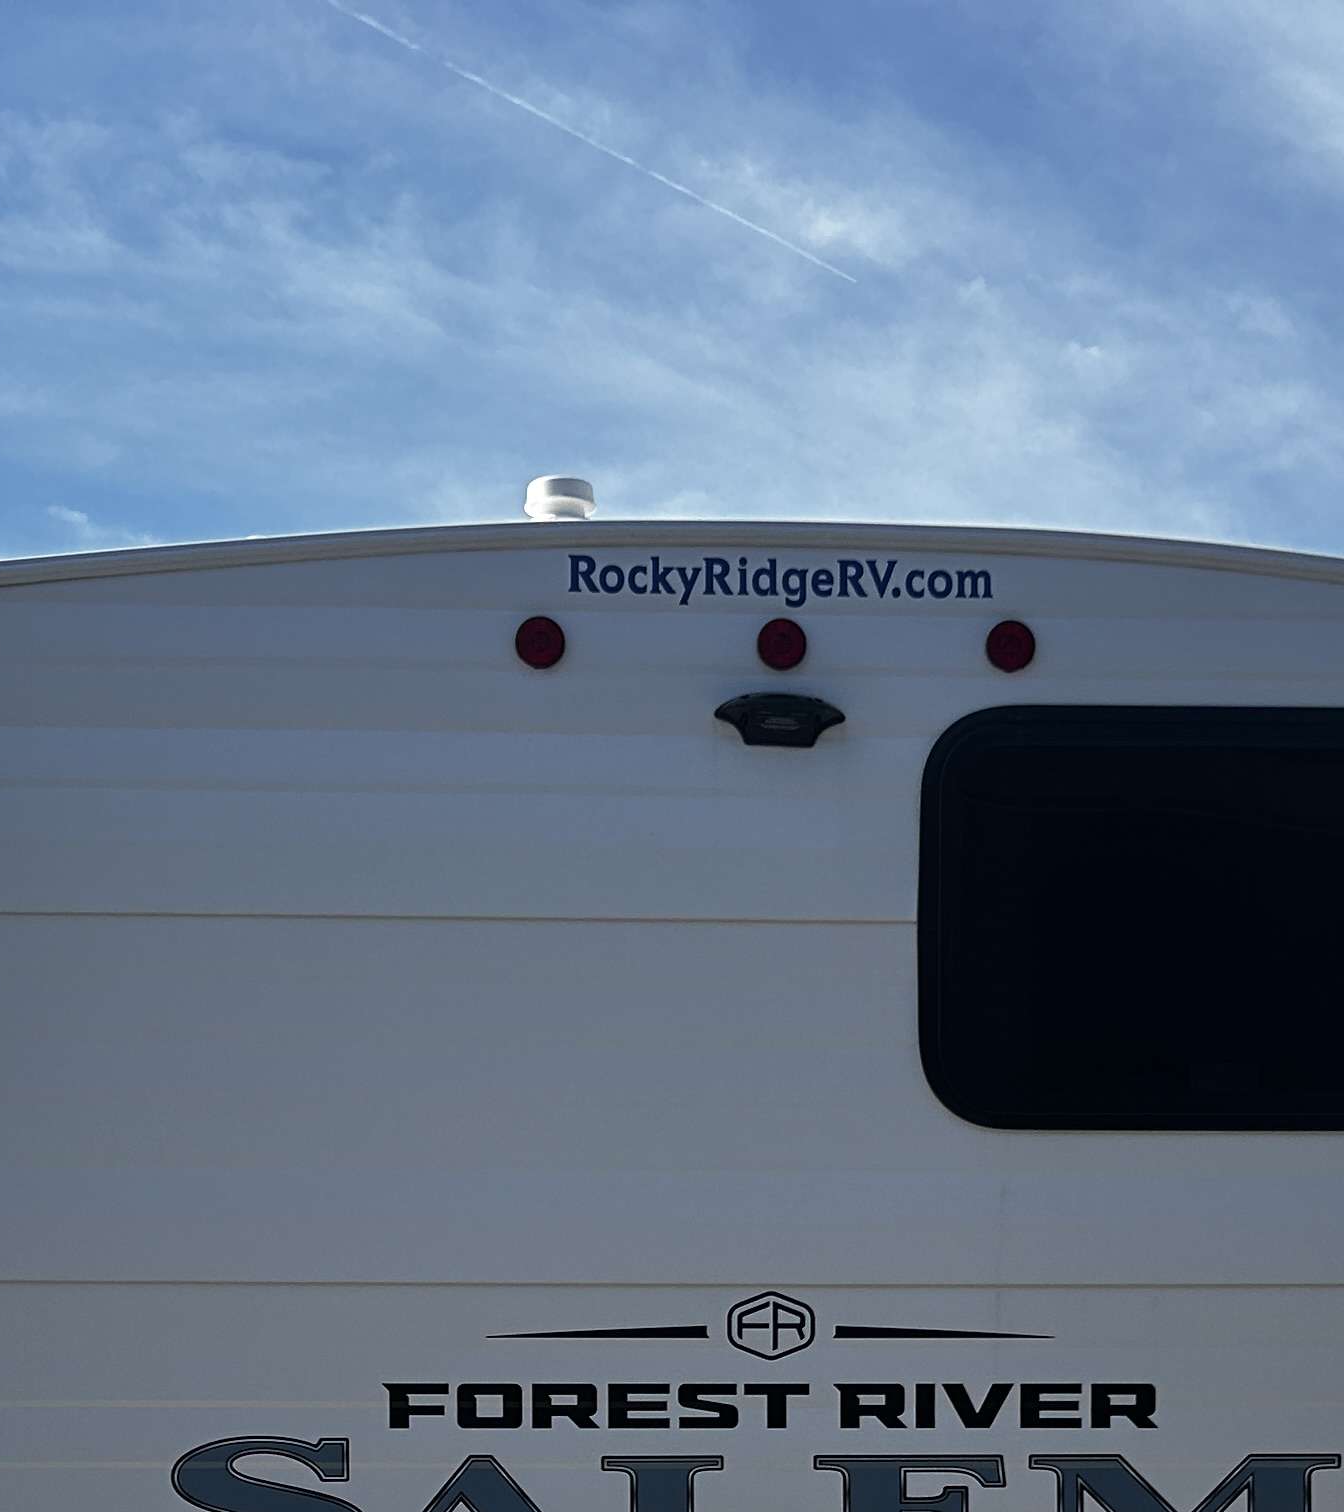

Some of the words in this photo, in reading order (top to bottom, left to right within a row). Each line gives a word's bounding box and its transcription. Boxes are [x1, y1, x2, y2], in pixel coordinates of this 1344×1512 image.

[567, 554, 994, 608] RockyRidgeRV.com
[381, 1382, 810, 1429] FOREST
[833, 1382, 1159, 1429] RIVER
